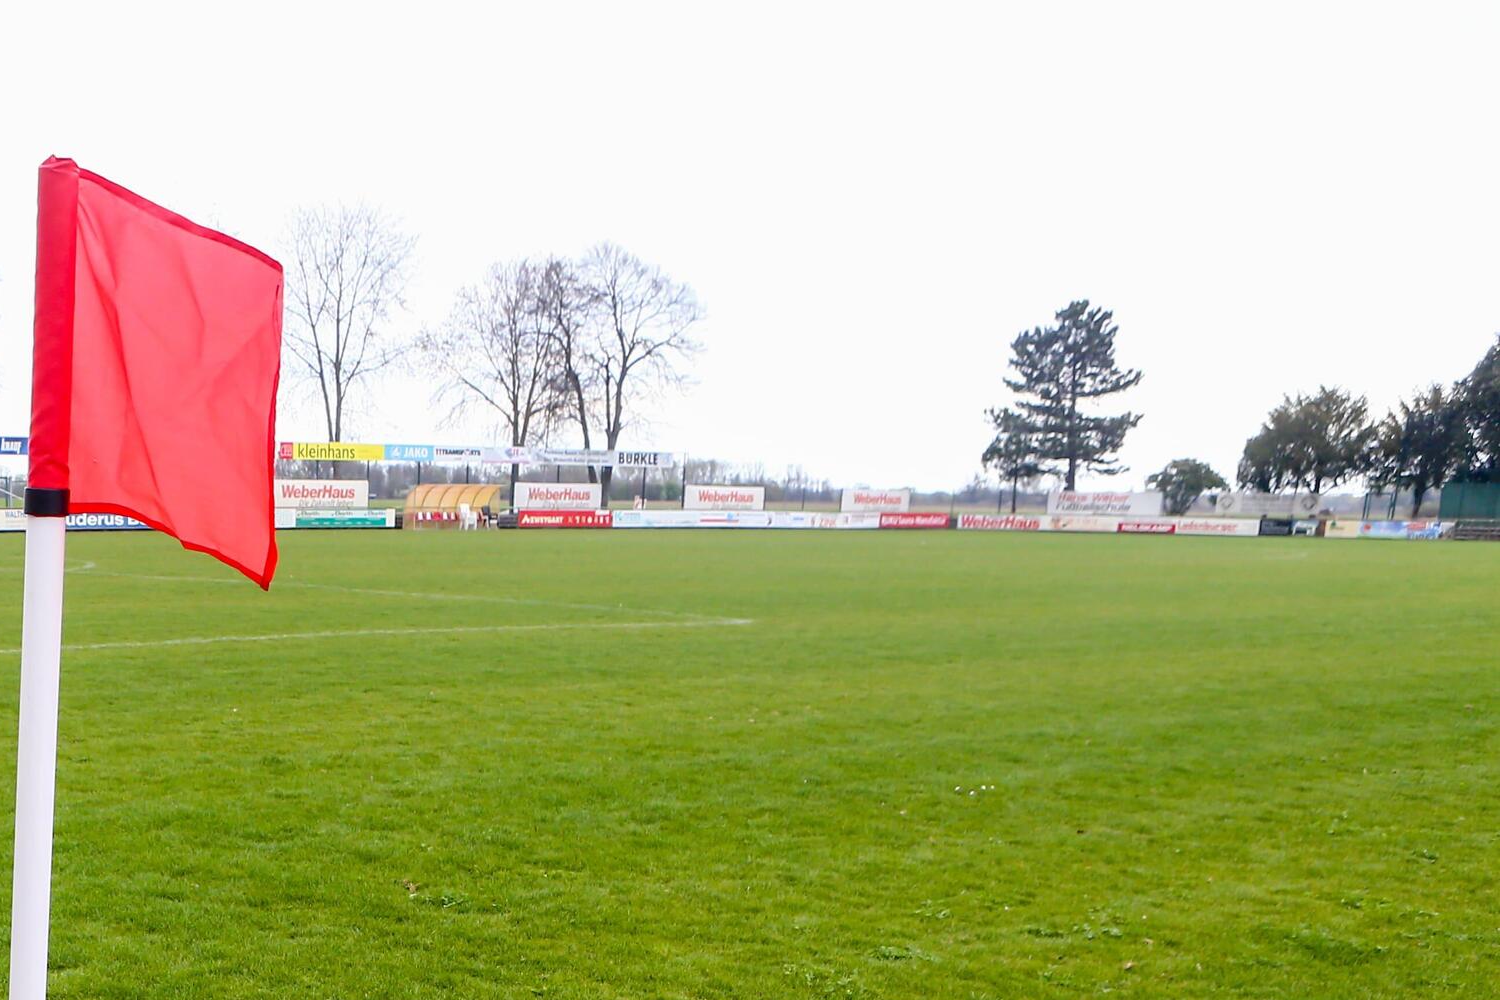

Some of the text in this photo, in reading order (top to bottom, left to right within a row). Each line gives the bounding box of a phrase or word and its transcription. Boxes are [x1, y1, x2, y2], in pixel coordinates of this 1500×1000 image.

[298, 443, 356, 459] kleinhans
[404, 447, 429, 458] JAKO
[281, 485, 356, 499] WeberHaus
[528, 487, 591, 501] WeberHaus
[698, 489, 755, 503] WeberHaus
[854, 492, 902, 505] WeberHaus
[65, 513, 125, 527] uderus
[961, 514, 1041, 530] WeberHaus
